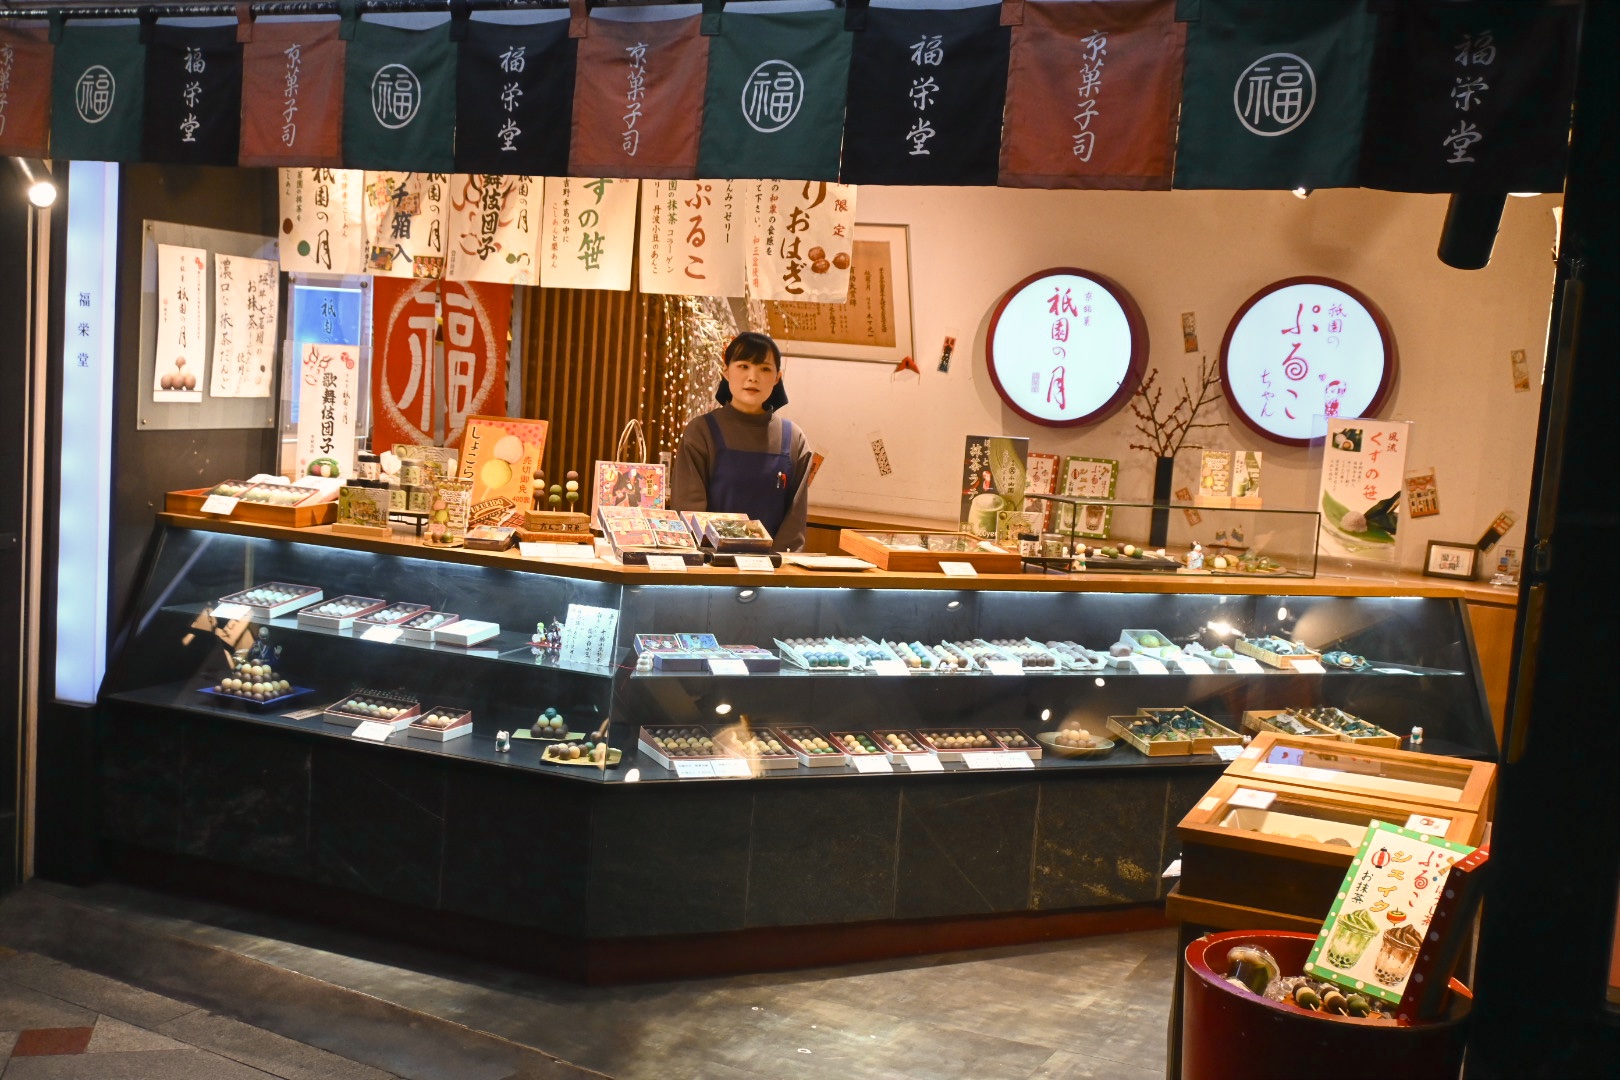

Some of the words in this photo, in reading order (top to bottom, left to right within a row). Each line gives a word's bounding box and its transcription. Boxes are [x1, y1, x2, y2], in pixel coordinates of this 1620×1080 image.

[80, 73, 109, 116] 福
[179, 45, 206, 144] 福栄堂
[279, 43, 302, 149] 京菓子司
[376, 74, 420, 120] 福
[497, 44, 526, 153] 福栄堂
[622, 41, 650, 157] 京菓子司
[748, 70, 796, 123] 福
[905, 33, 945, 157] 福栄堂
[1071, 28, 1109, 164] 京菓子司
[1243, 65, 1306, 127] 福
[1442, 28, 1498, 166] 福栄堂
[577, 178, 614, 272] すの笹
[684, 183, 712, 280] ぷるこ
[754, 178, 763, 228] て下さい。
[766, 178, 781, 256] の和栗の食感を
[783, 180, 828, 295] りおはぎ
[832, 181, 850, 238] 限定
[77, 292, 91, 368] 福栄堂
[398, 291, 476, 432] 福
[1047, 287, 1079, 411] 祇園の月
[1281, 303, 1321, 420] ぷるこ
[1328, 303, 1347, 349] 祇園の
[319, 372, 337, 454] 歌舞伎団子
[1261, 369, 1275, 418] ちゃん
[463, 426, 480, 478] しょこら
[969, 443, 983, 501] 抹茶ラテ
[1362, 431, 1384, 501] くすの笹
[1351, 869, 1374, 905] お抹茶
[1369, 850, 1413, 913] シェイク
[1410, 850, 1444, 908] ぷるこ
